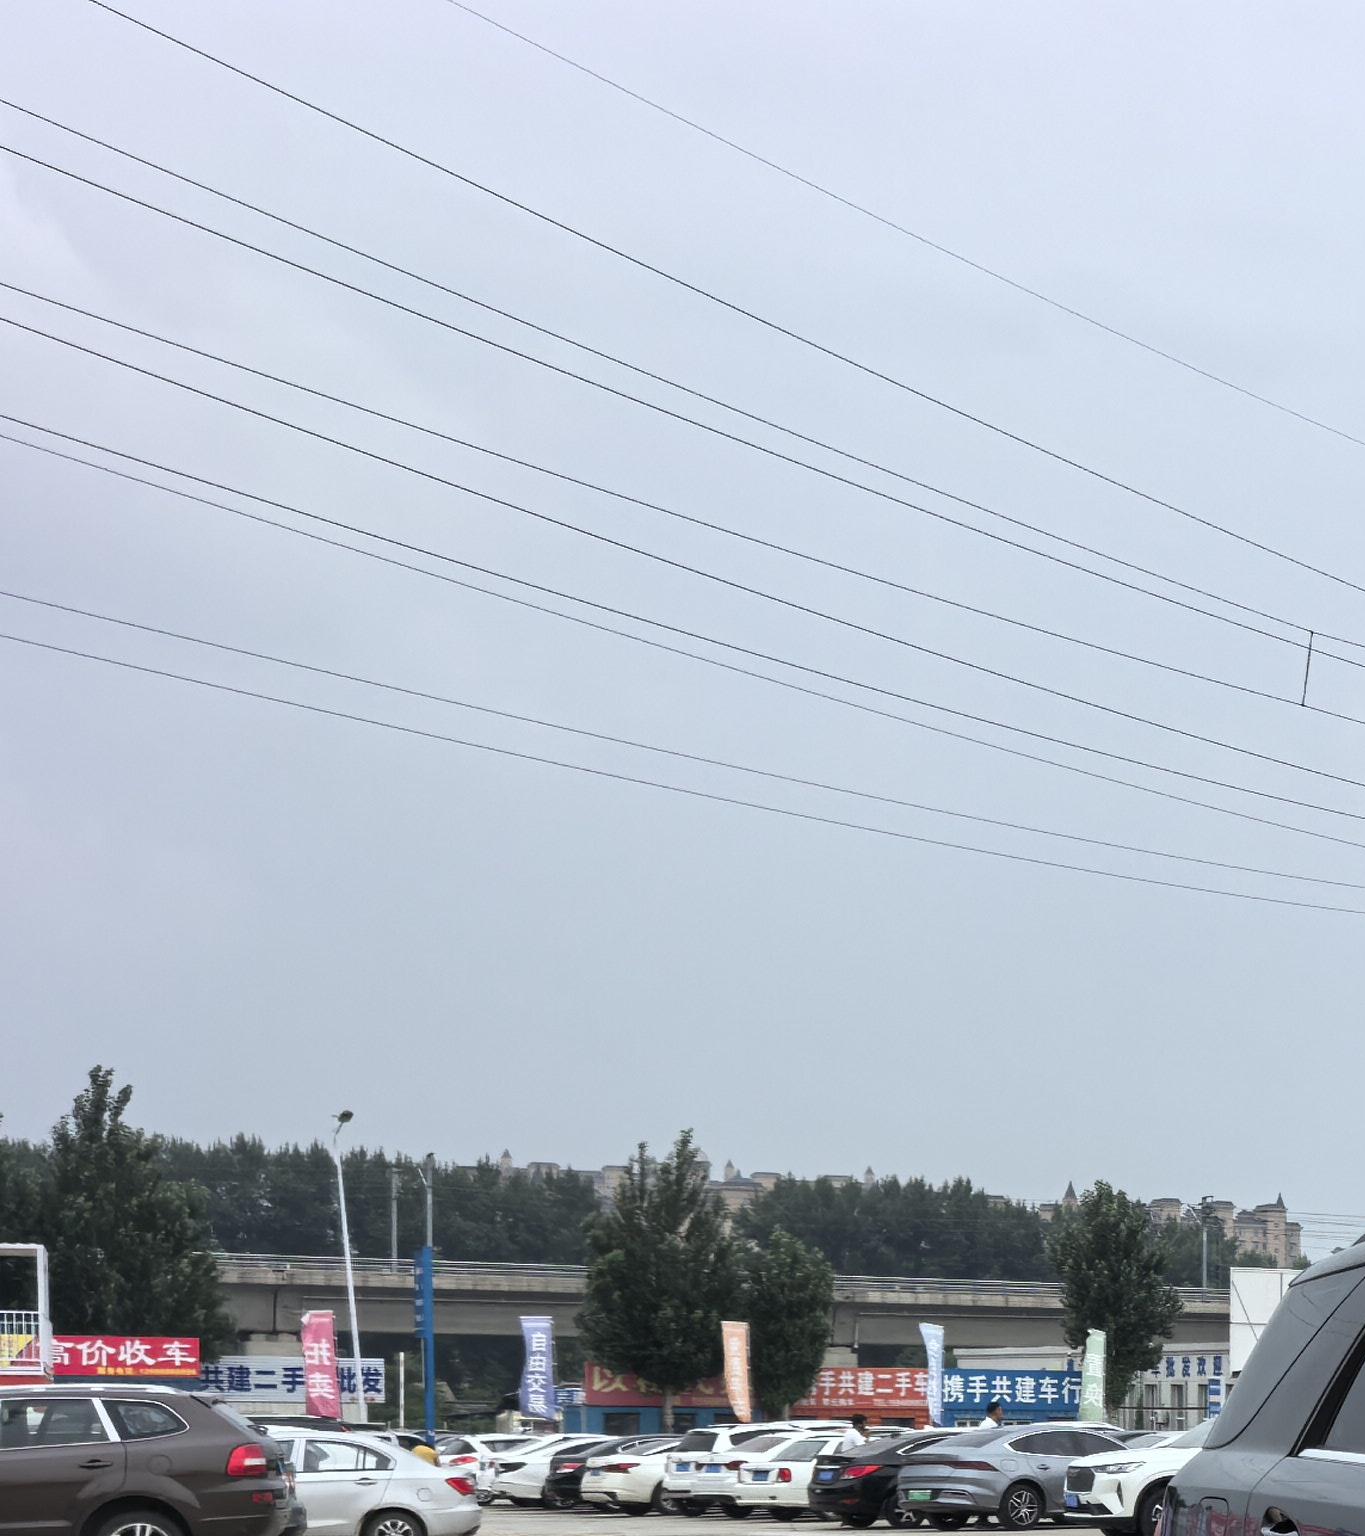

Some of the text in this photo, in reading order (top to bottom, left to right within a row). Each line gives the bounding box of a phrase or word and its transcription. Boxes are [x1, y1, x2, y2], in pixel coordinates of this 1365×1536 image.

[37, 1340, 197, 1366] 高价收车
[200, 1365, 383, 1393] 共建二手批发
[811, 1371, 928, 1396] 手共建二手车
[943, 1374, 1082, 1404] 携手共建车行
